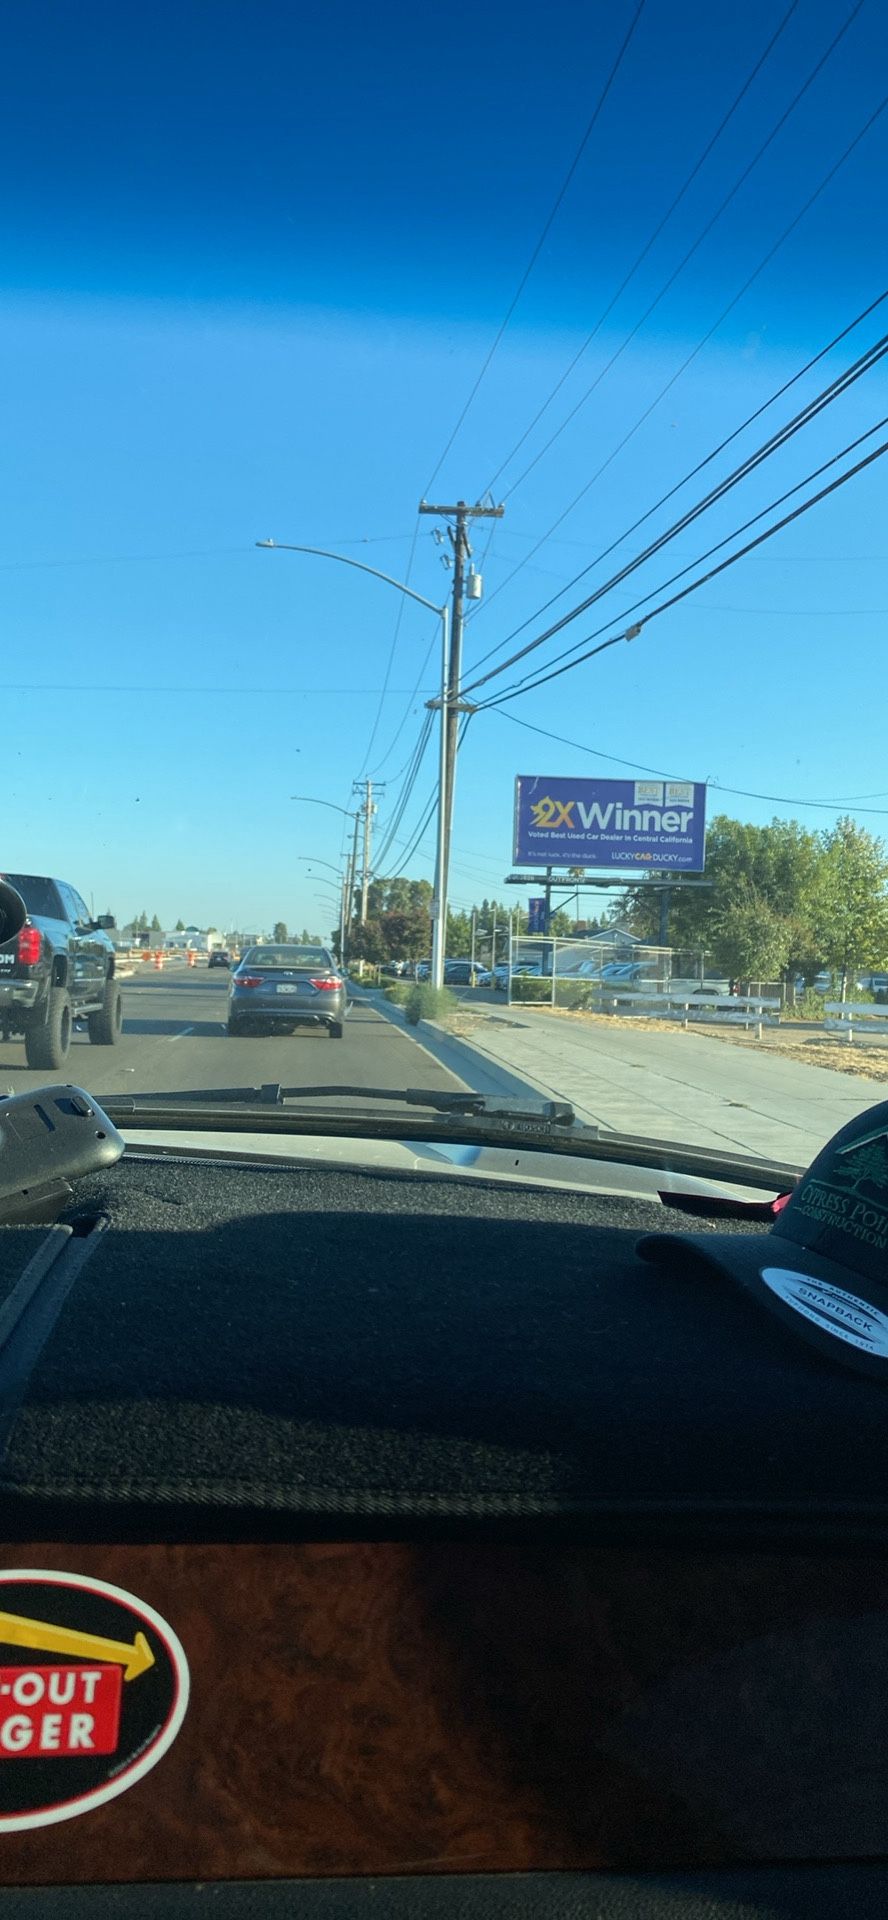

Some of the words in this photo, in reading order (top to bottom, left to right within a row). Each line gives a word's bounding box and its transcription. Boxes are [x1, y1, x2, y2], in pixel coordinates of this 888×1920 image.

[530, 795, 575, 829] 2X
[577, 801, 694, 833] Winner
[567, 832, 585, 840] Used
[600, 833, 623, 841] Dealer
[633, 834, 659, 843] Central
[660, 835, 693, 844] California
[801, 1184, 850, 1214] CYPRESS
[801, 1205, 887, 1249] CONSTRUCTION
[798, 1287, 874, 1332] SNAPBACK
[806, 1277, 823, 1286] THE
[829, 1286, 882, 1316] AUTHENTIC
[825, 1323, 849, 1339] SINCE
[0, 1712, 95, 1752] GER
